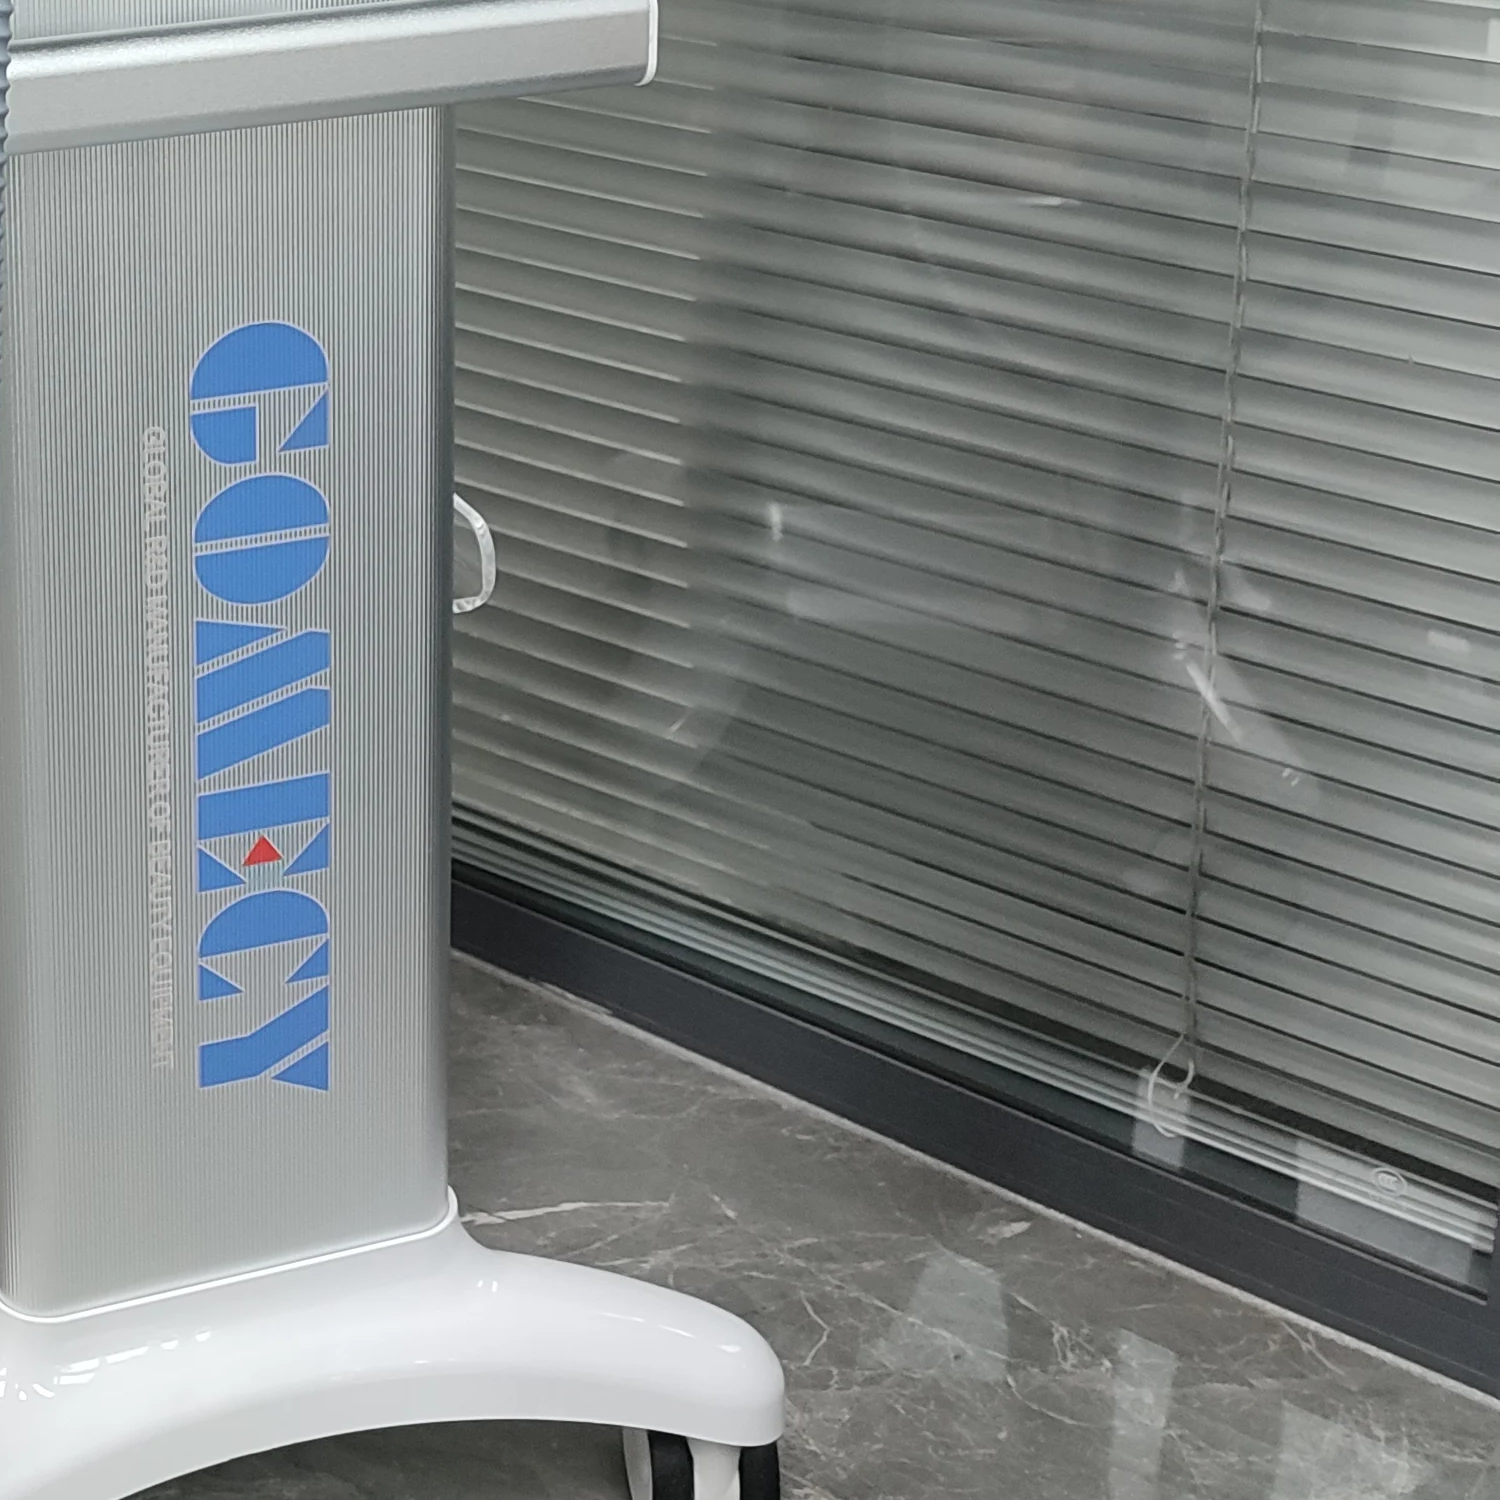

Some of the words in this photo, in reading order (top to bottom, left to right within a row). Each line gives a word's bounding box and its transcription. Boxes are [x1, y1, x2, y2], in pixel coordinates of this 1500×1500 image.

[143, 426, 167, 530] GLOBAL
[144, 534, 168, 586] R&D
[146, 593, 170, 795] MANUFACTURER
[148, 801, 171, 835] OF
[149, 840, 173, 932] BEAUTY
[150, 936, 175, 1069] EQUIPMENT
